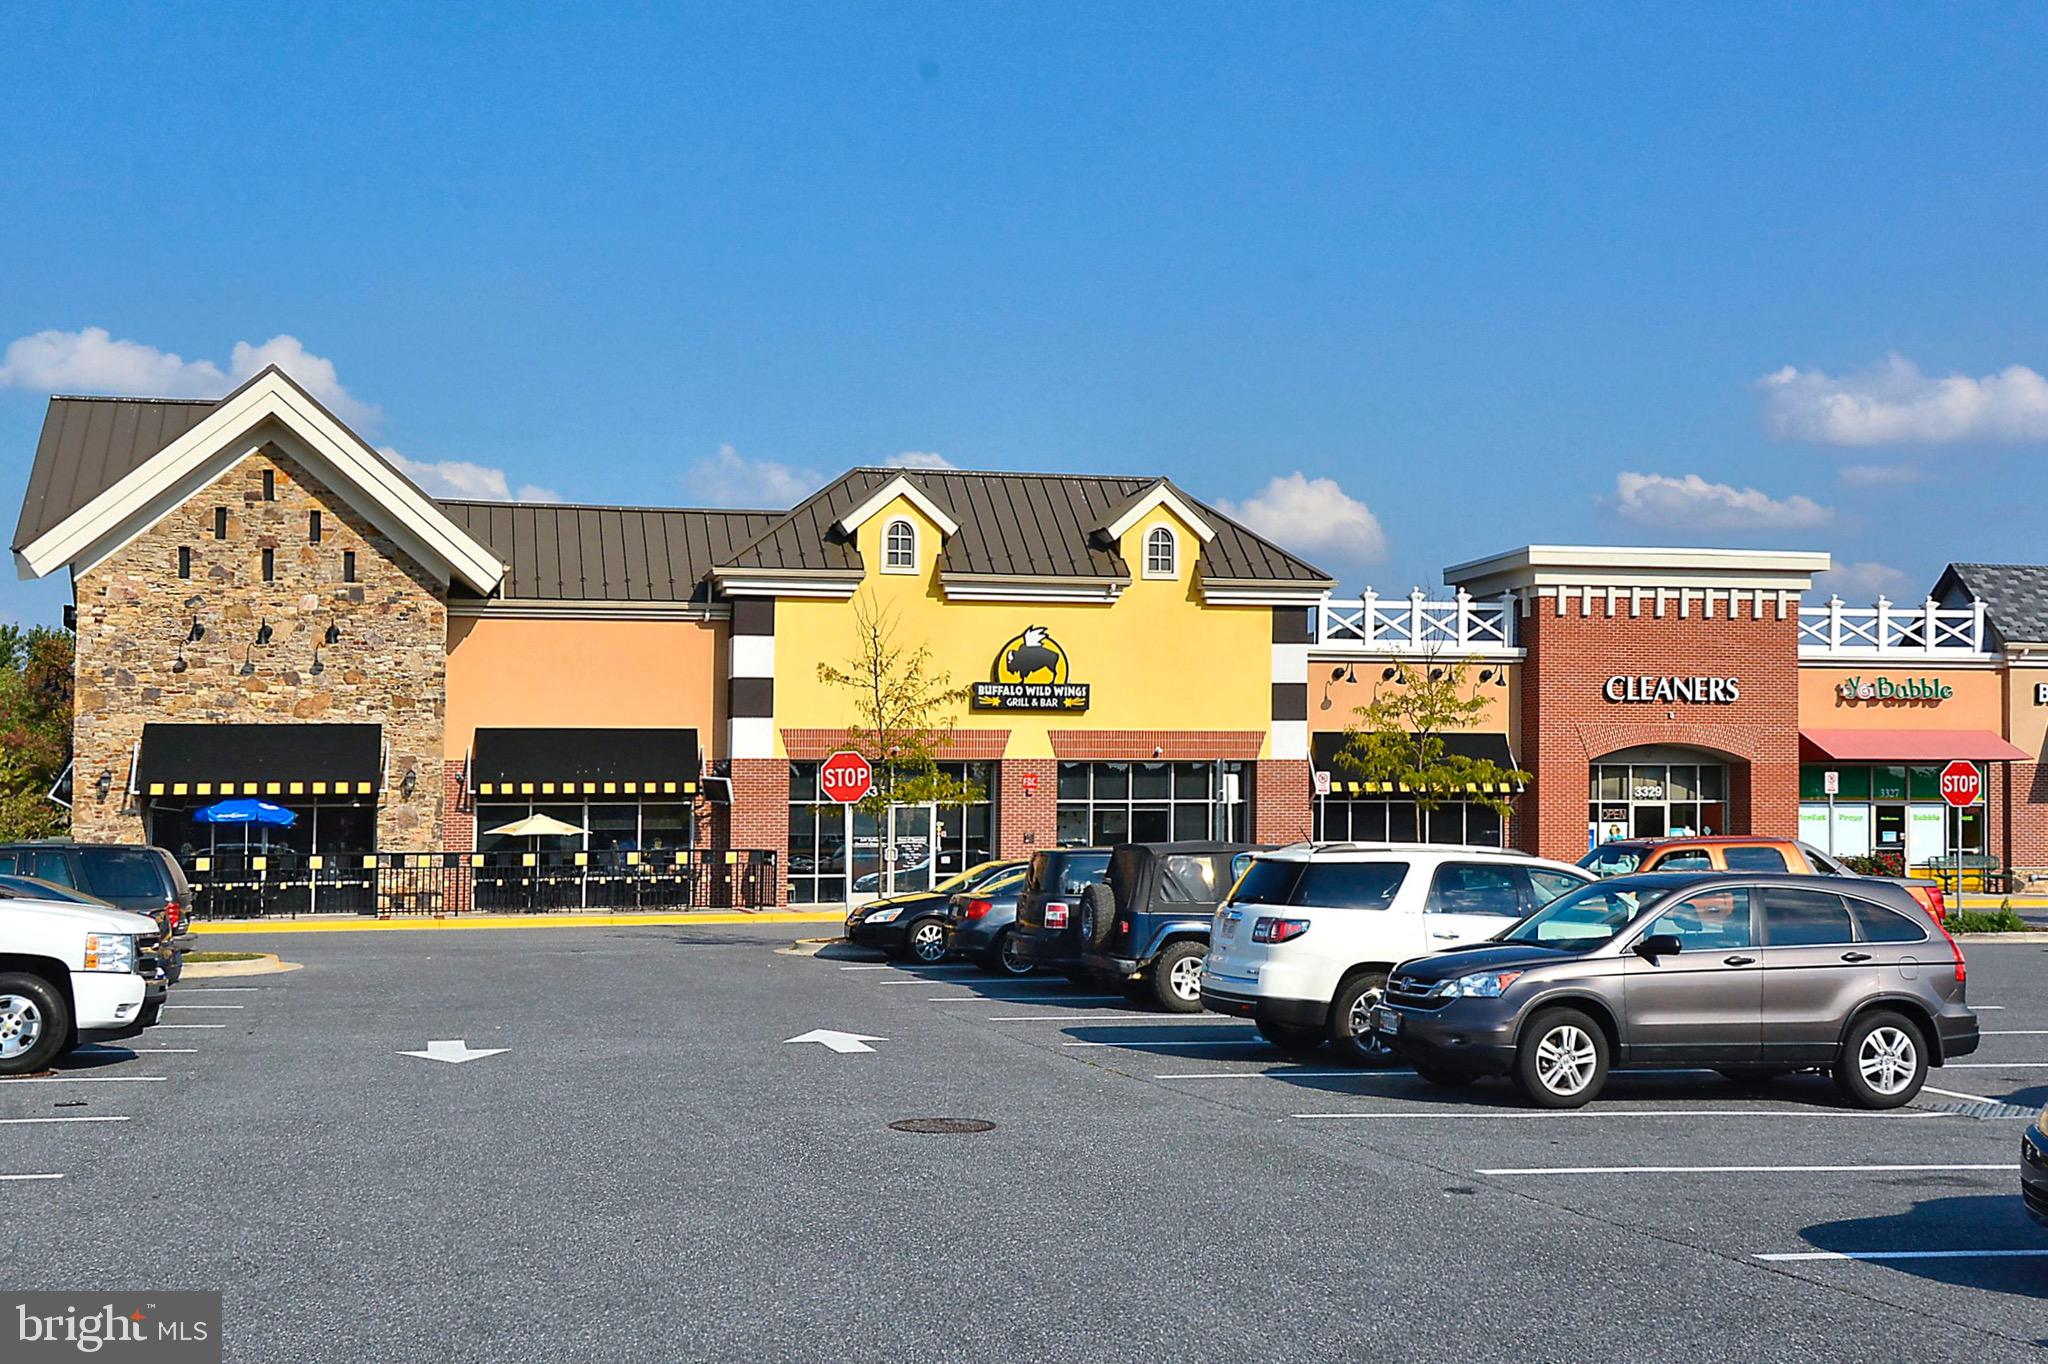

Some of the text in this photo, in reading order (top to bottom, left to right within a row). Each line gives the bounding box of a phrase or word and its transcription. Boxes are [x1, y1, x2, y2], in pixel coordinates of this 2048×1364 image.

[978, 685, 1087, 697] BUFFALO WILD WINGS
[1606, 676, 1740, 702] CLEANERS
[1876, 677, 1953, 699] Bubble
[1006, 697, 1058, 707] GRILL & BAR
[825, 767, 868, 788] STOP
[1943, 775, 1978, 793] STOP
[1634, 786, 1662, 797] 3329
[1880, 788, 1900, 798] 3327
[1602, 808, 1627, 820] OPEN
